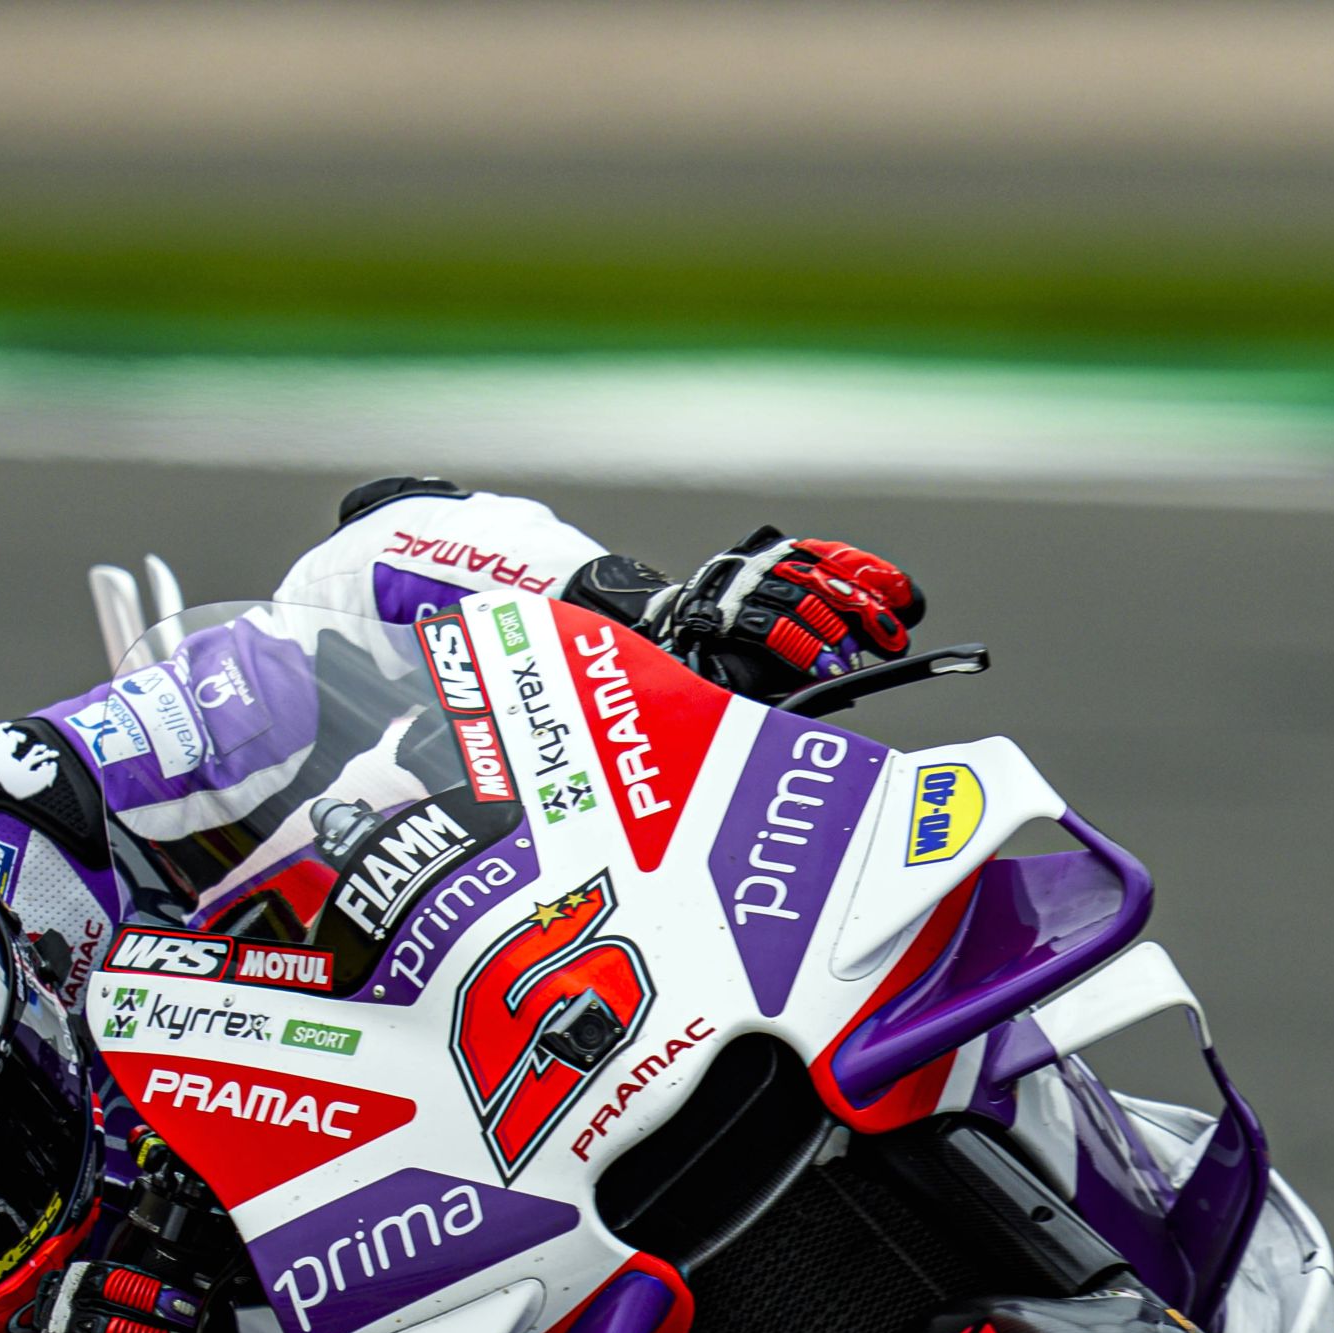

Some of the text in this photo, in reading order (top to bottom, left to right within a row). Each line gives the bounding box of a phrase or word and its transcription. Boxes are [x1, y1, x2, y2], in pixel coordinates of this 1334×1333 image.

[384, 531, 556, 594] PRAMAC
[424, 624, 486, 709] WRS
[502, 611, 525, 647] SPORT
[460, 721, 509, 797] MOTUL
[512, 661, 570, 776] kyrrex
[574, 626, 672, 819] PRAMAC
[734, 731, 848, 925] prima
[915, 772, 956, 857] WD-40
[335, 804, 469, 934] FIAMM
[111, 934, 227, 976] WRS
[391, 858, 516, 988] prima
[239, 950, 329, 984] MOTUL
[147, 994, 269, 1040] kyrrex
[292, 1027, 351, 1050] SPORT
[142, 1068, 359, 1139] PRAMAC
[570, 1017, 717, 1161] PRAMAC
[273, 1184, 484, 1332] prima
